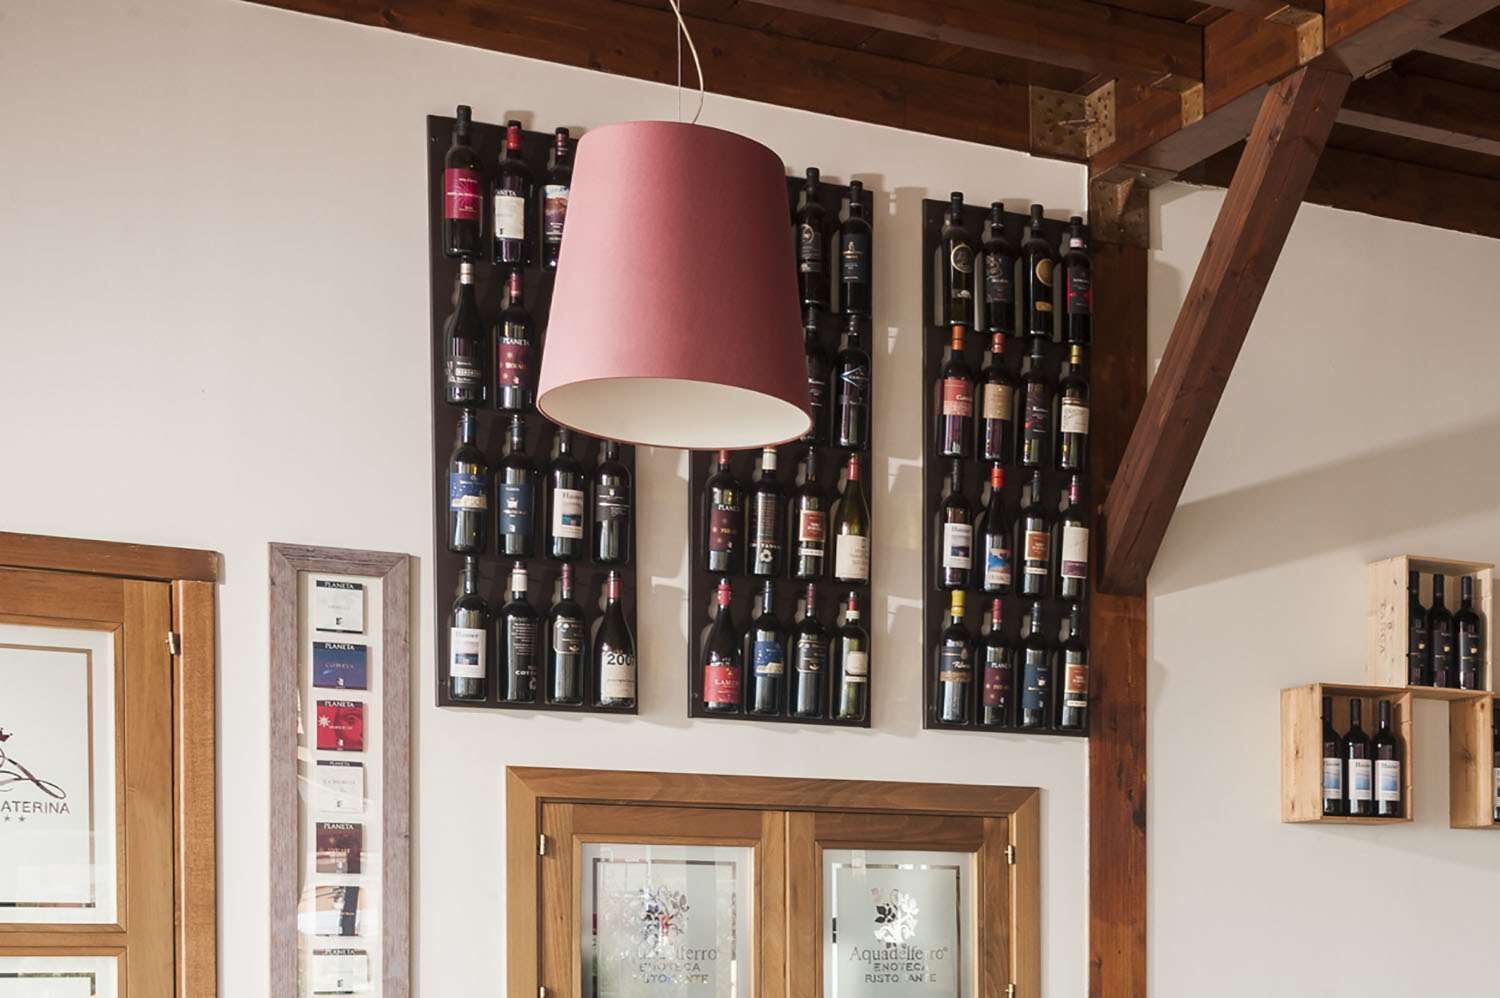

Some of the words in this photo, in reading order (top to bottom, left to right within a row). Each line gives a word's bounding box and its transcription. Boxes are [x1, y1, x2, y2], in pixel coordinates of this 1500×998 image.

[324, 581, 355, 590] PLANETA
[324, 642, 355, 651] PLANETA
[324, 700, 355, 709] PLANETA
[324, 823, 354, 832] PLANETA
[864, 973, 937, 983] RISTOANE
